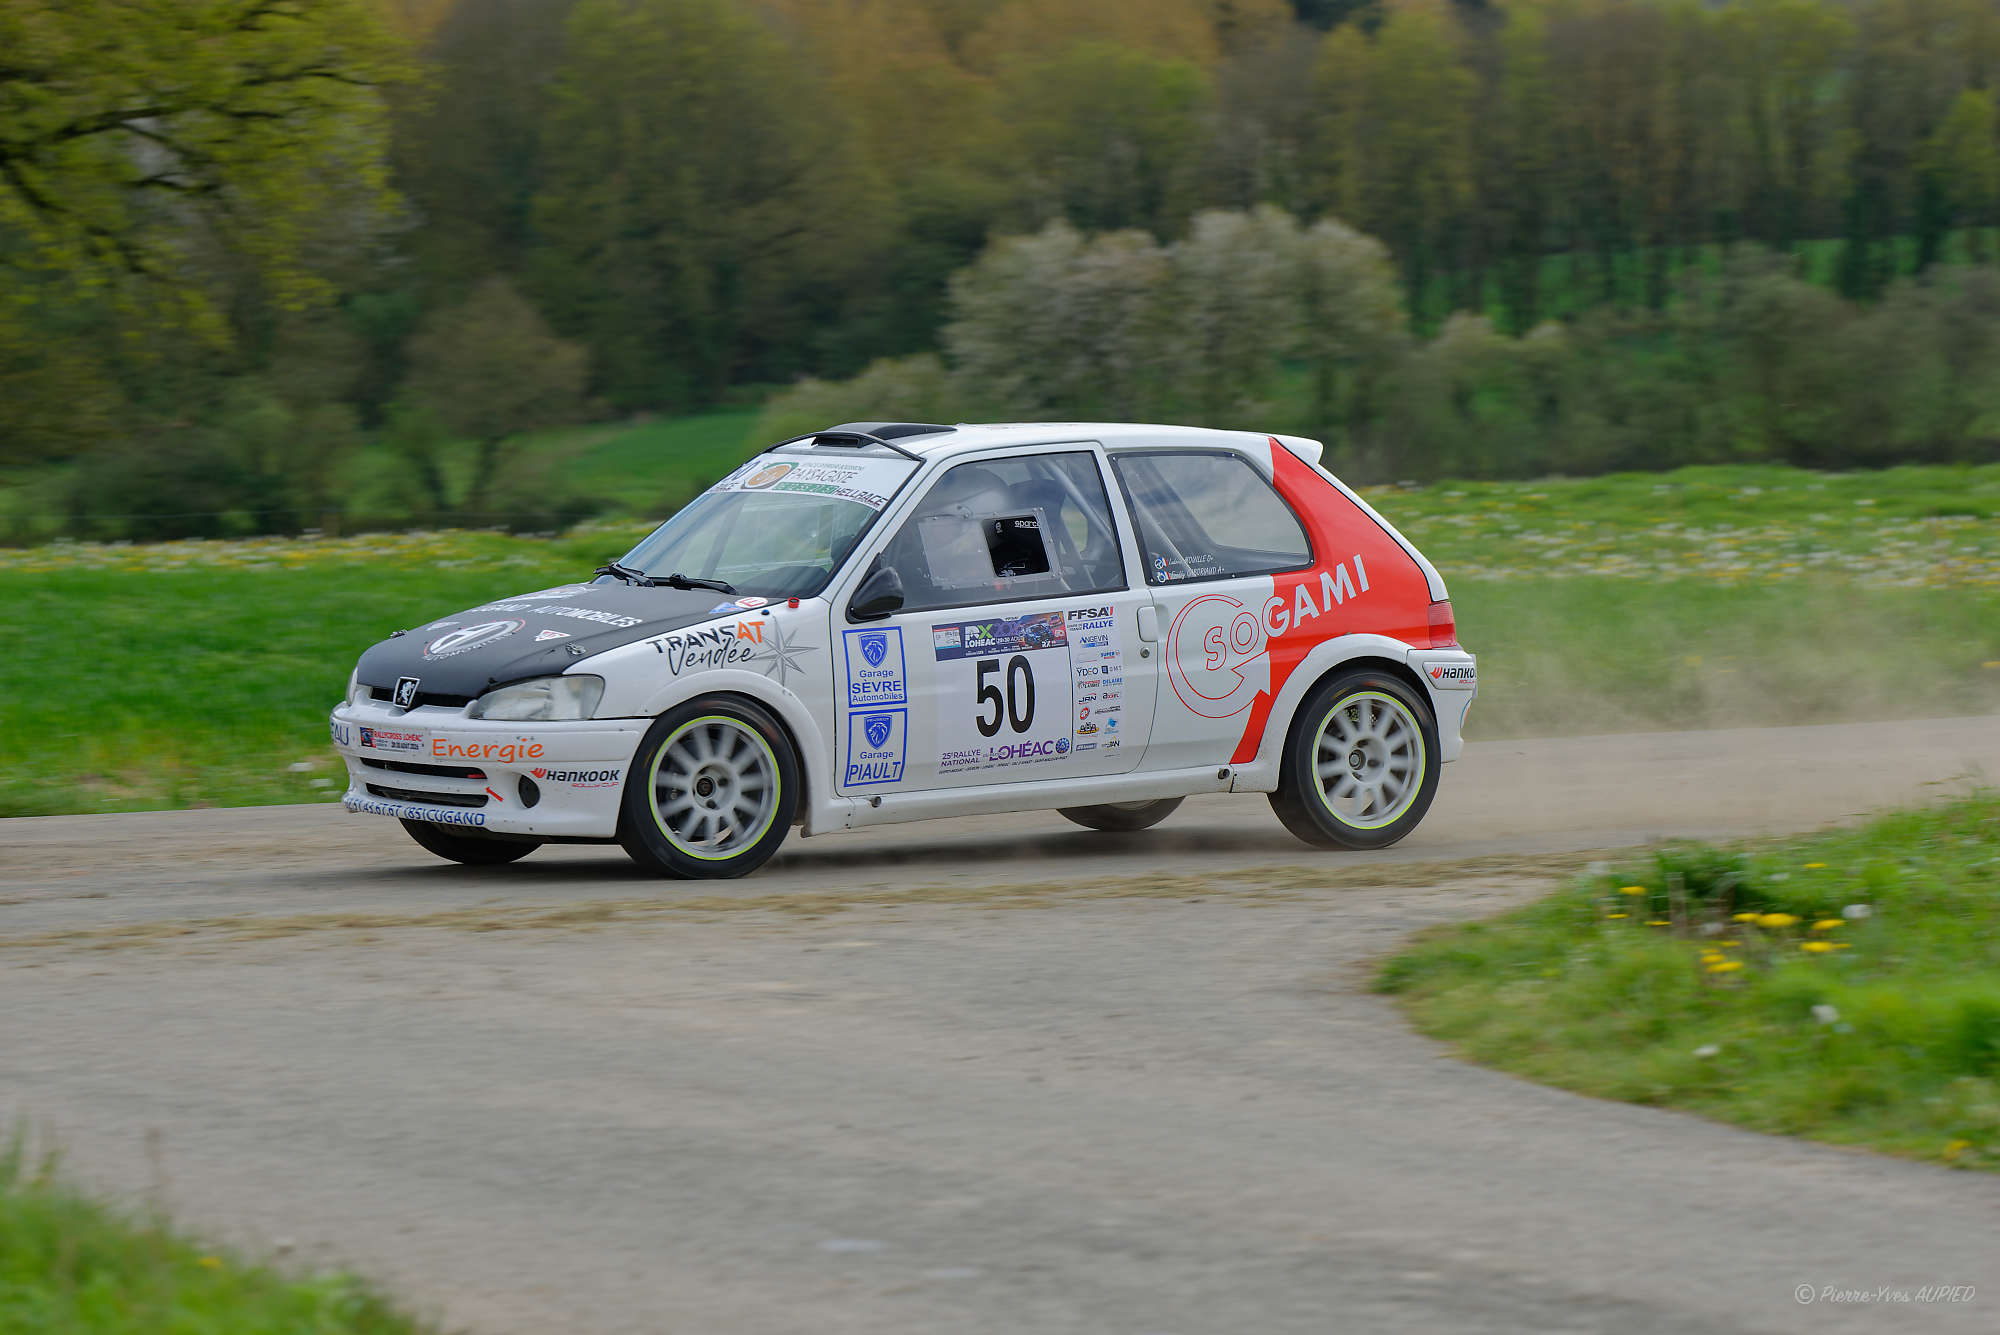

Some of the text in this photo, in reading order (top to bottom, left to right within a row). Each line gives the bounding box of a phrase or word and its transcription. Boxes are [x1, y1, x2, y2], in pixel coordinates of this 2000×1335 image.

[528, 604, 643, 627] AUTOMOBILES
[1068, 606, 1109, 621] FFSA
[1204, 554, 1370, 671] SOGAMI
[965, 624, 993, 641] RX
[1082, 620, 1113, 630] RALLYE
[646, 621, 765, 654] TRANSAT
[668, 637, 755, 676] Vendée
[859, 669, 894, 679] Garage
[852, 679, 902, 694] SÈVRE
[852, 692, 903, 703] Automobiles
[976, 655, 1035, 738] 50
[432, 738, 545, 764] Energie
[859, 751, 894, 761] Garage
[953, 749, 981, 759] RALLYE
[989, 740, 1054, 762] LOHÉAC
[848, 761, 901, 782] PIAULT
[941, 757, 980, 767] NATIONAL
